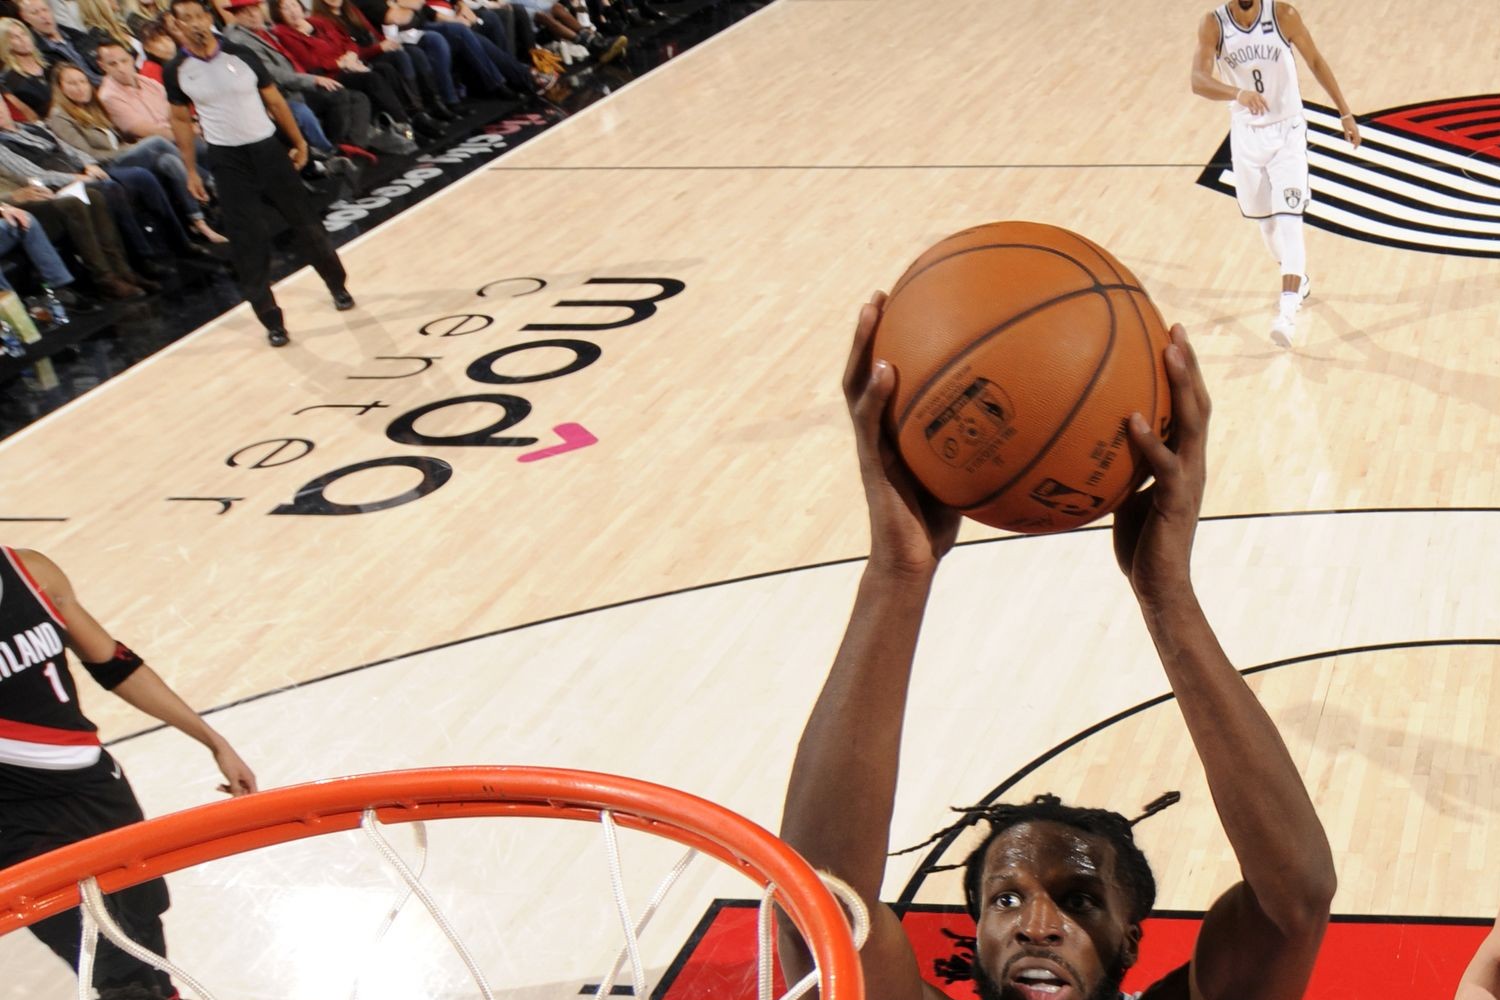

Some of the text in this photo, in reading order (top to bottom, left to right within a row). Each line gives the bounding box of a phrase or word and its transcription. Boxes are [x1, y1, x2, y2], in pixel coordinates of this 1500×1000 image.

[1224, 44, 1281, 69] BROOKLYN
[1252, 69, 1264, 93] 8
[167, 277, 547, 515] center
[267, 277, 686, 517] moda
[0, 622, 63, 682] TLAND
[43, 662, 70, 703] 1
